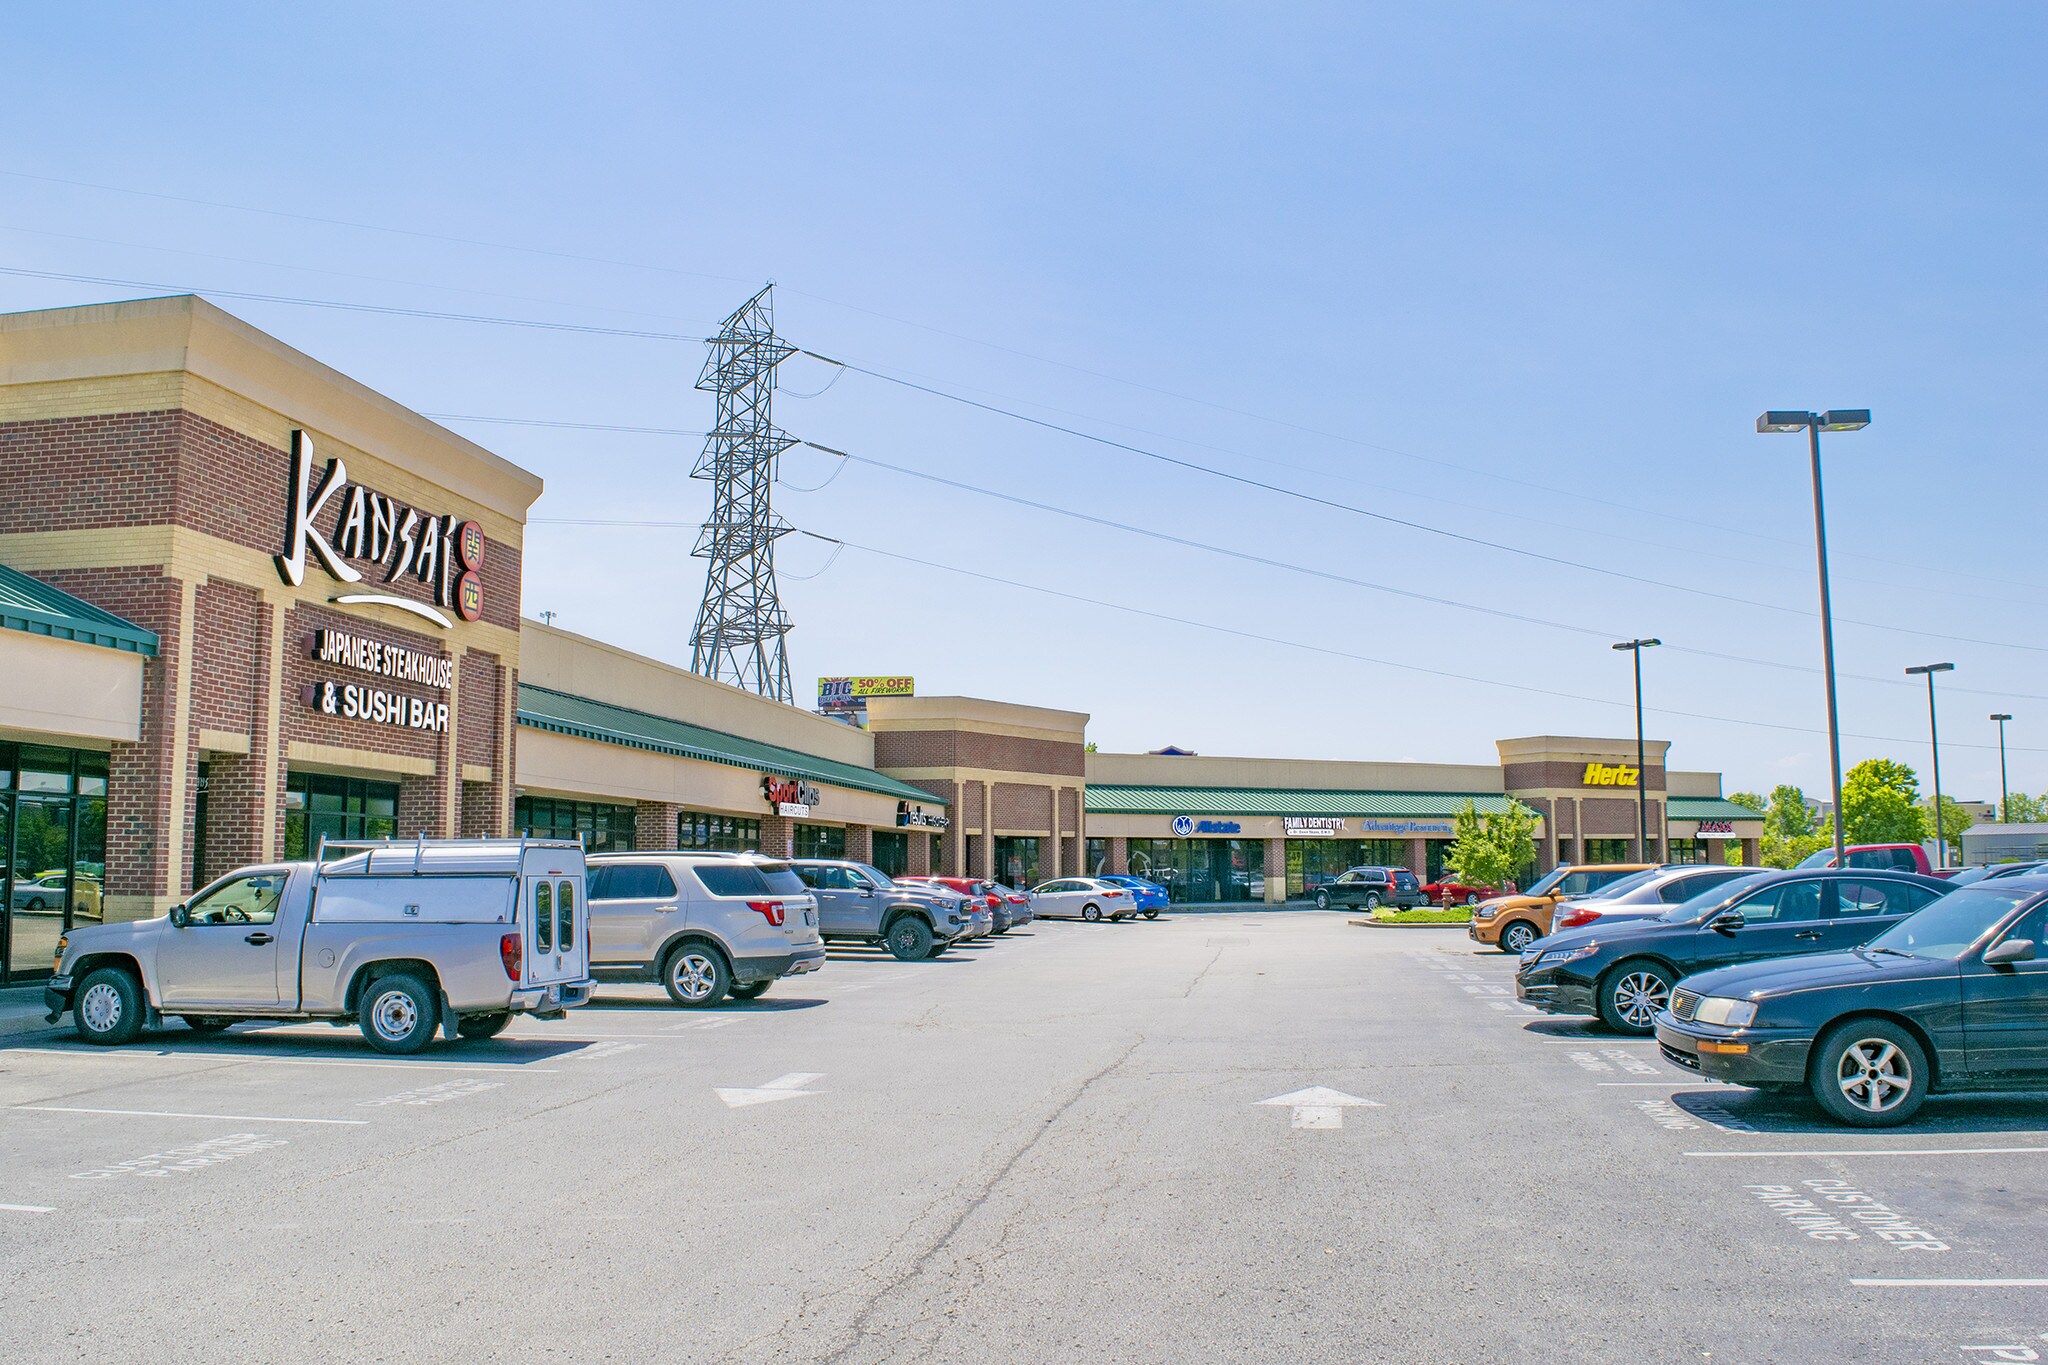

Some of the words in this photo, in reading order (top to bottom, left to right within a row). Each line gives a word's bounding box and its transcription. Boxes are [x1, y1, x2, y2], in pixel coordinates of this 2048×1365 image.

[320, 628, 382, 674] JAPANESE
[383, 644, 453, 690] STEAKHOUSE
[820, 681, 854, 697] BIG
[858, 678, 885, 688] 50%
[886, 678, 912, 688] OFF
[322, 681, 337, 714] &
[342, 684, 407, 726] SUSHI
[409, 698, 449, 733] BAR
[1582, 763, 1640, 786] Hertz
[780, 804, 808, 816] HAIRCUTS
[1196, 820, 1242, 834] Allstate
[1284, 816, 1308, 830] FAMILY
[1308, 816, 1346, 831] DENTISTRY
[1742, 1183, 1861, 1241] PARKING
[1801, 1177, 1952, 1251] CUSTOMER
